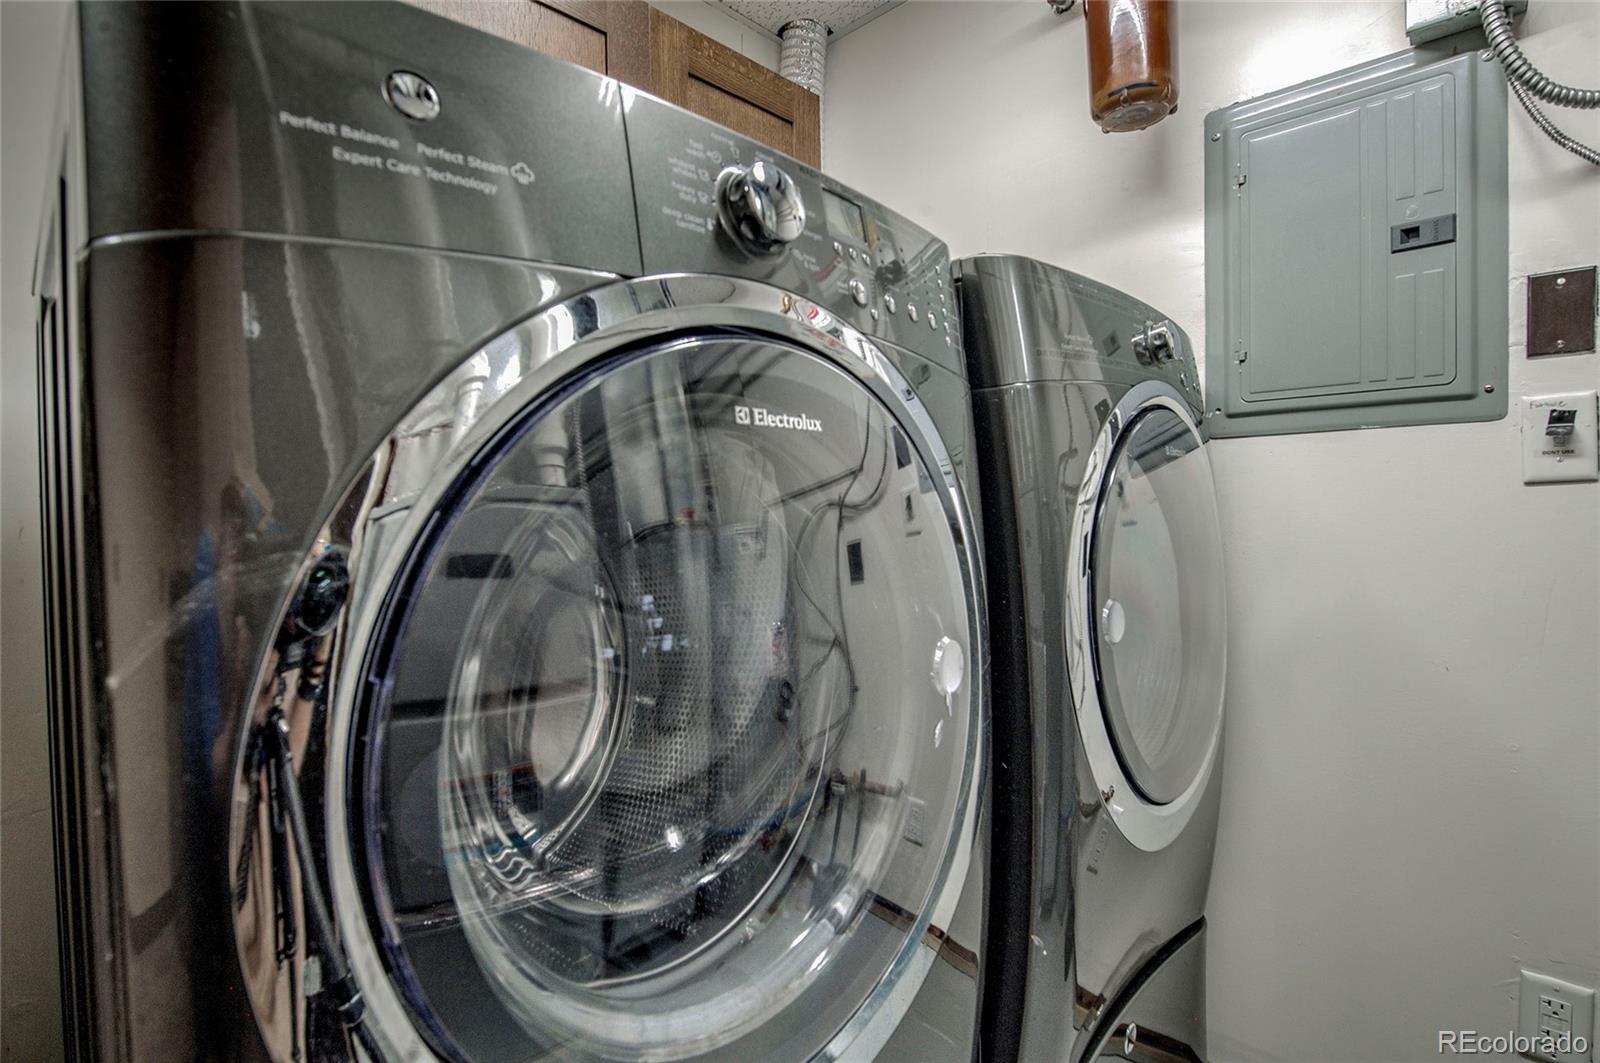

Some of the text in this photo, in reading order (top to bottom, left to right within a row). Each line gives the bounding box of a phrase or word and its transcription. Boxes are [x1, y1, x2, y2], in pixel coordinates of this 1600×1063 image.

[279, 110, 399, 149] Perfect Balance
[332, 146, 498, 195] Expert Care Technology
[417, 142, 509, 176] Perfect Steam
[752, 407, 823, 432] Electrolux
